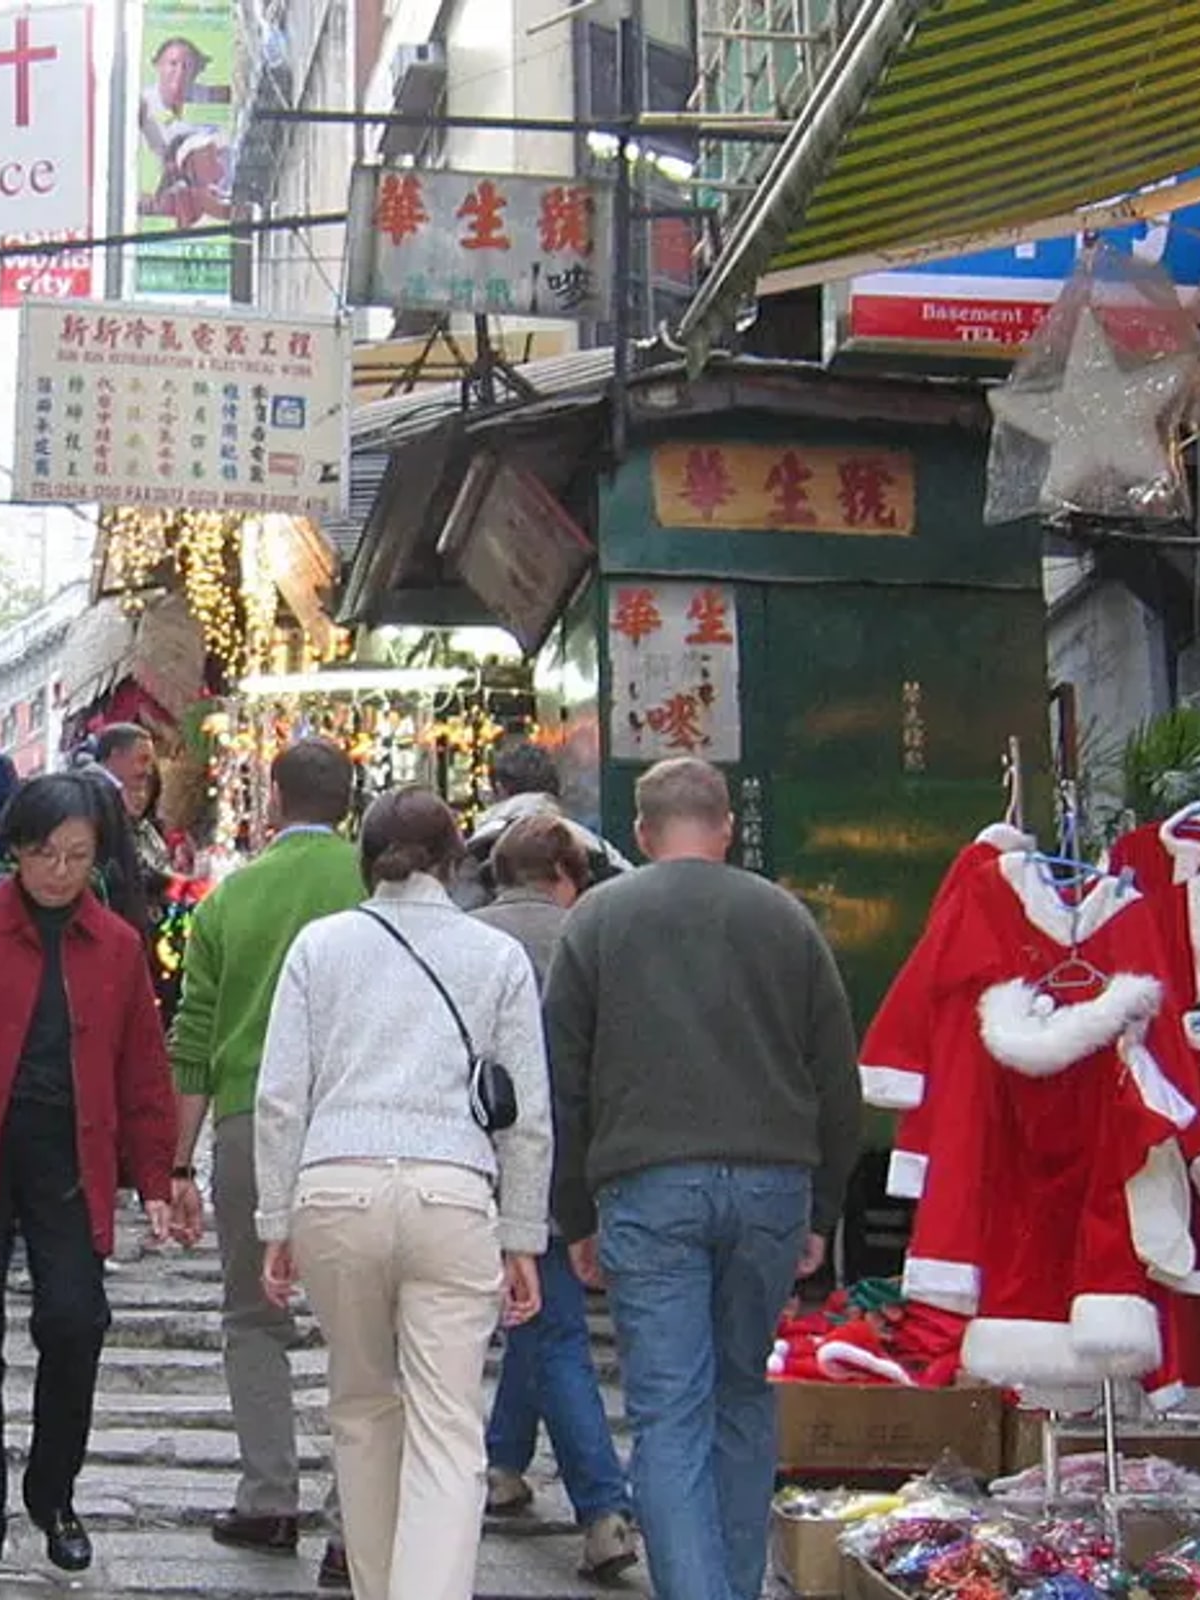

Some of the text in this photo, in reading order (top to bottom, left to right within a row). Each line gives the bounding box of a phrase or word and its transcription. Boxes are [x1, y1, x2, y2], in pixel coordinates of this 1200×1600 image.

[16, 269, 73, 297] city
[922, 303, 1022, 323] Basement
[611, 587, 733, 647] 華生
